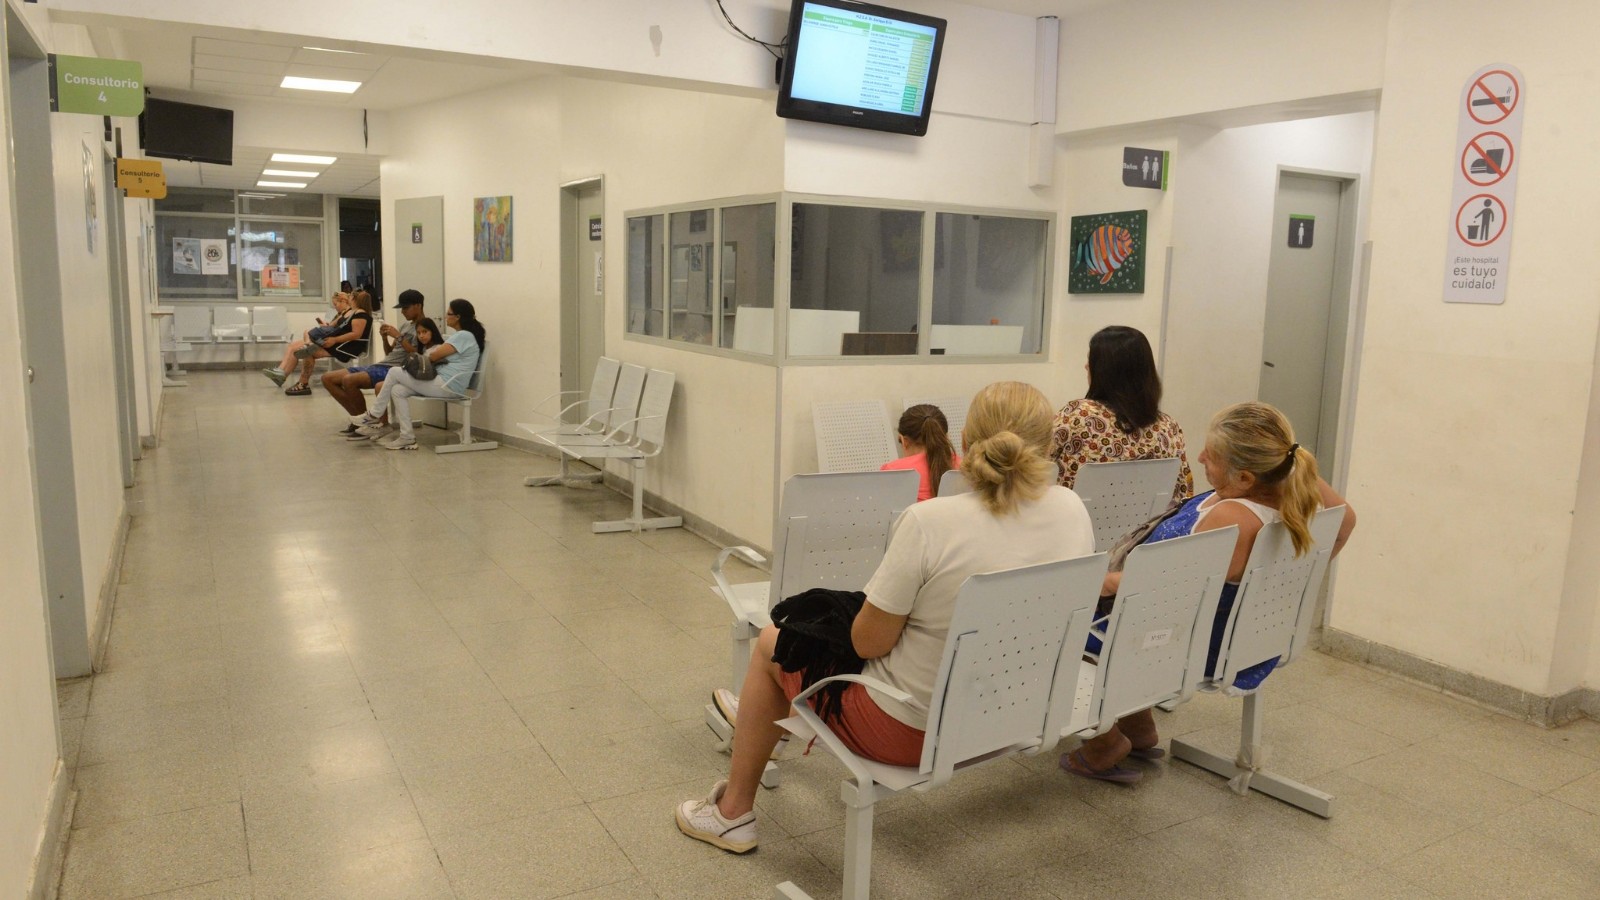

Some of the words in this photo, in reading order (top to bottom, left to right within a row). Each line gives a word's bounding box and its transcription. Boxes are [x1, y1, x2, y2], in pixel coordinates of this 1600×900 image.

[64, 73, 139, 89] Consultorio
[98, 91, 107, 103] 4
[120, 169, 160, 178] Consultorio
[1472, 256, 1499, 265] hospital
[1453, 267, 1467, 276] es
[1471, 265, 1498, 279] tuyo
[1451, 278, 1496, 290] cuidalo!
